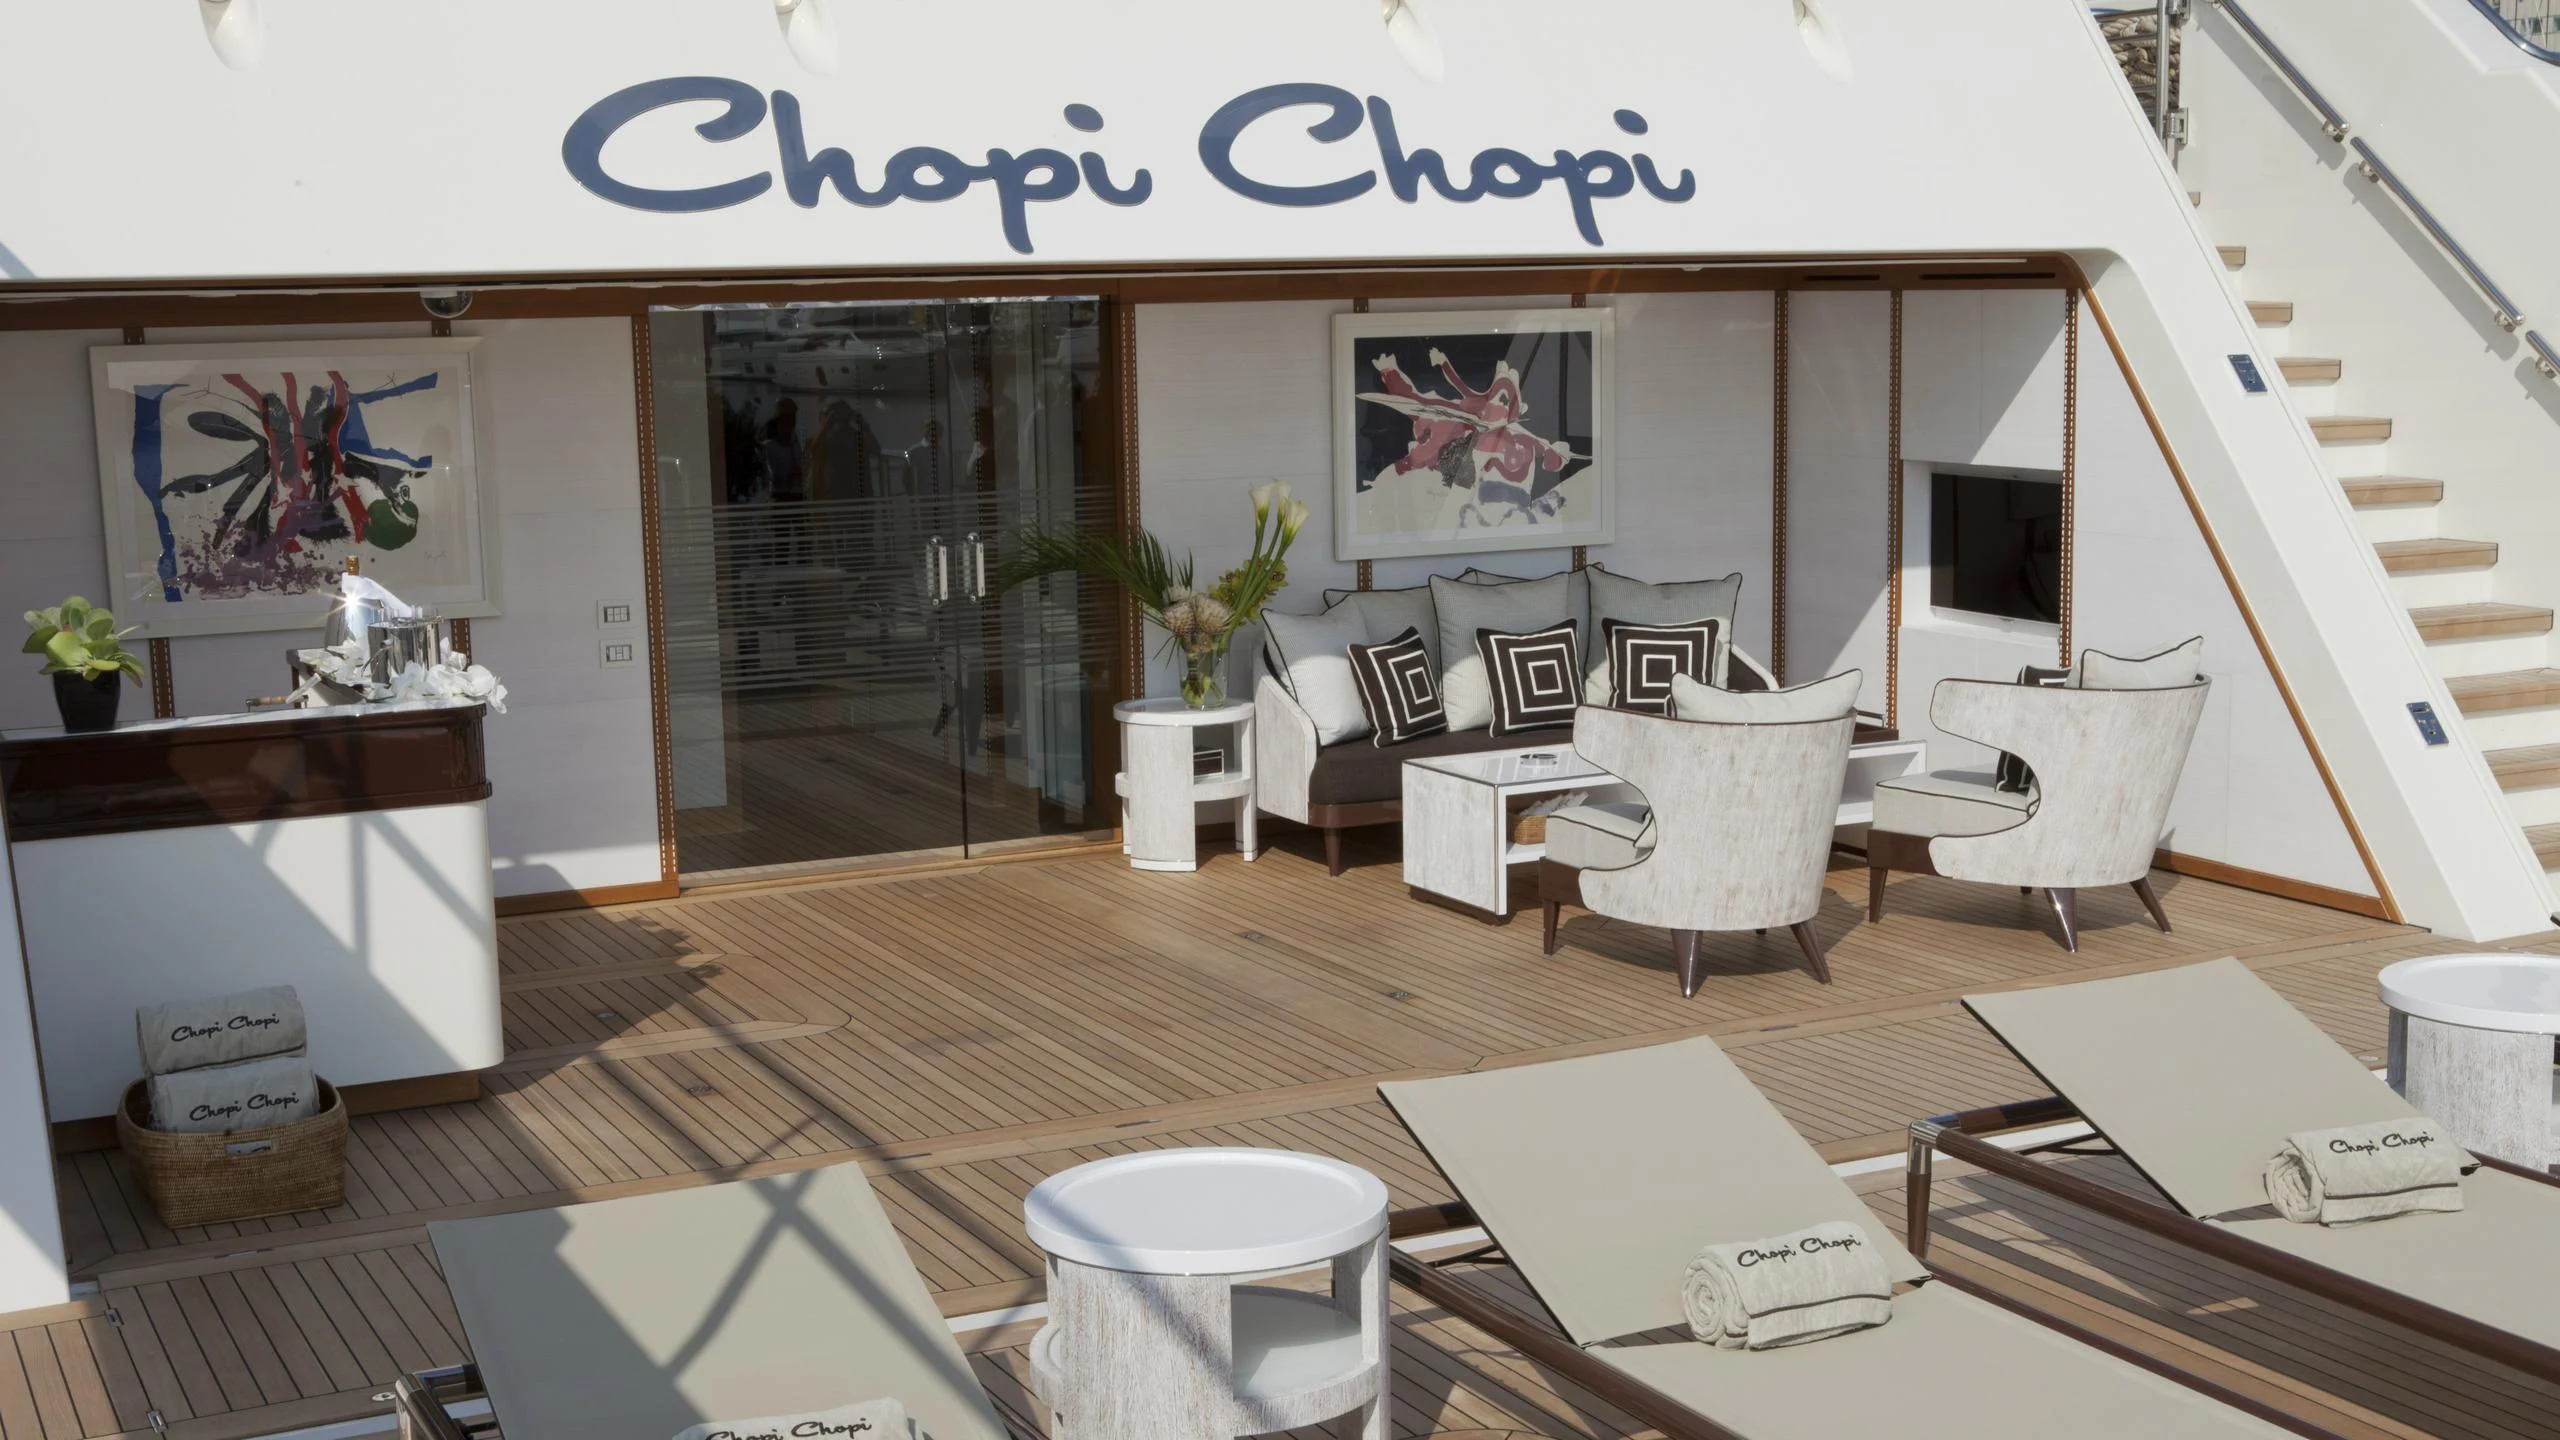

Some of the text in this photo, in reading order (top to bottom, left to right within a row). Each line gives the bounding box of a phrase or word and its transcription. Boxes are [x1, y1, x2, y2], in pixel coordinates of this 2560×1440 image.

[562, 76, 1696, 254] Chopi Chopi
[171, 1013, 280, 1042] Chopi Chopi
[189, 1092, 299, 1121] Chopi Chopi
[2329, 1131, 2434, 1156] Chopi Chopi
[1737, 1235, 1861, 1267] Chopi Chopi
[791, 1418, 873, 1439] Chopi
